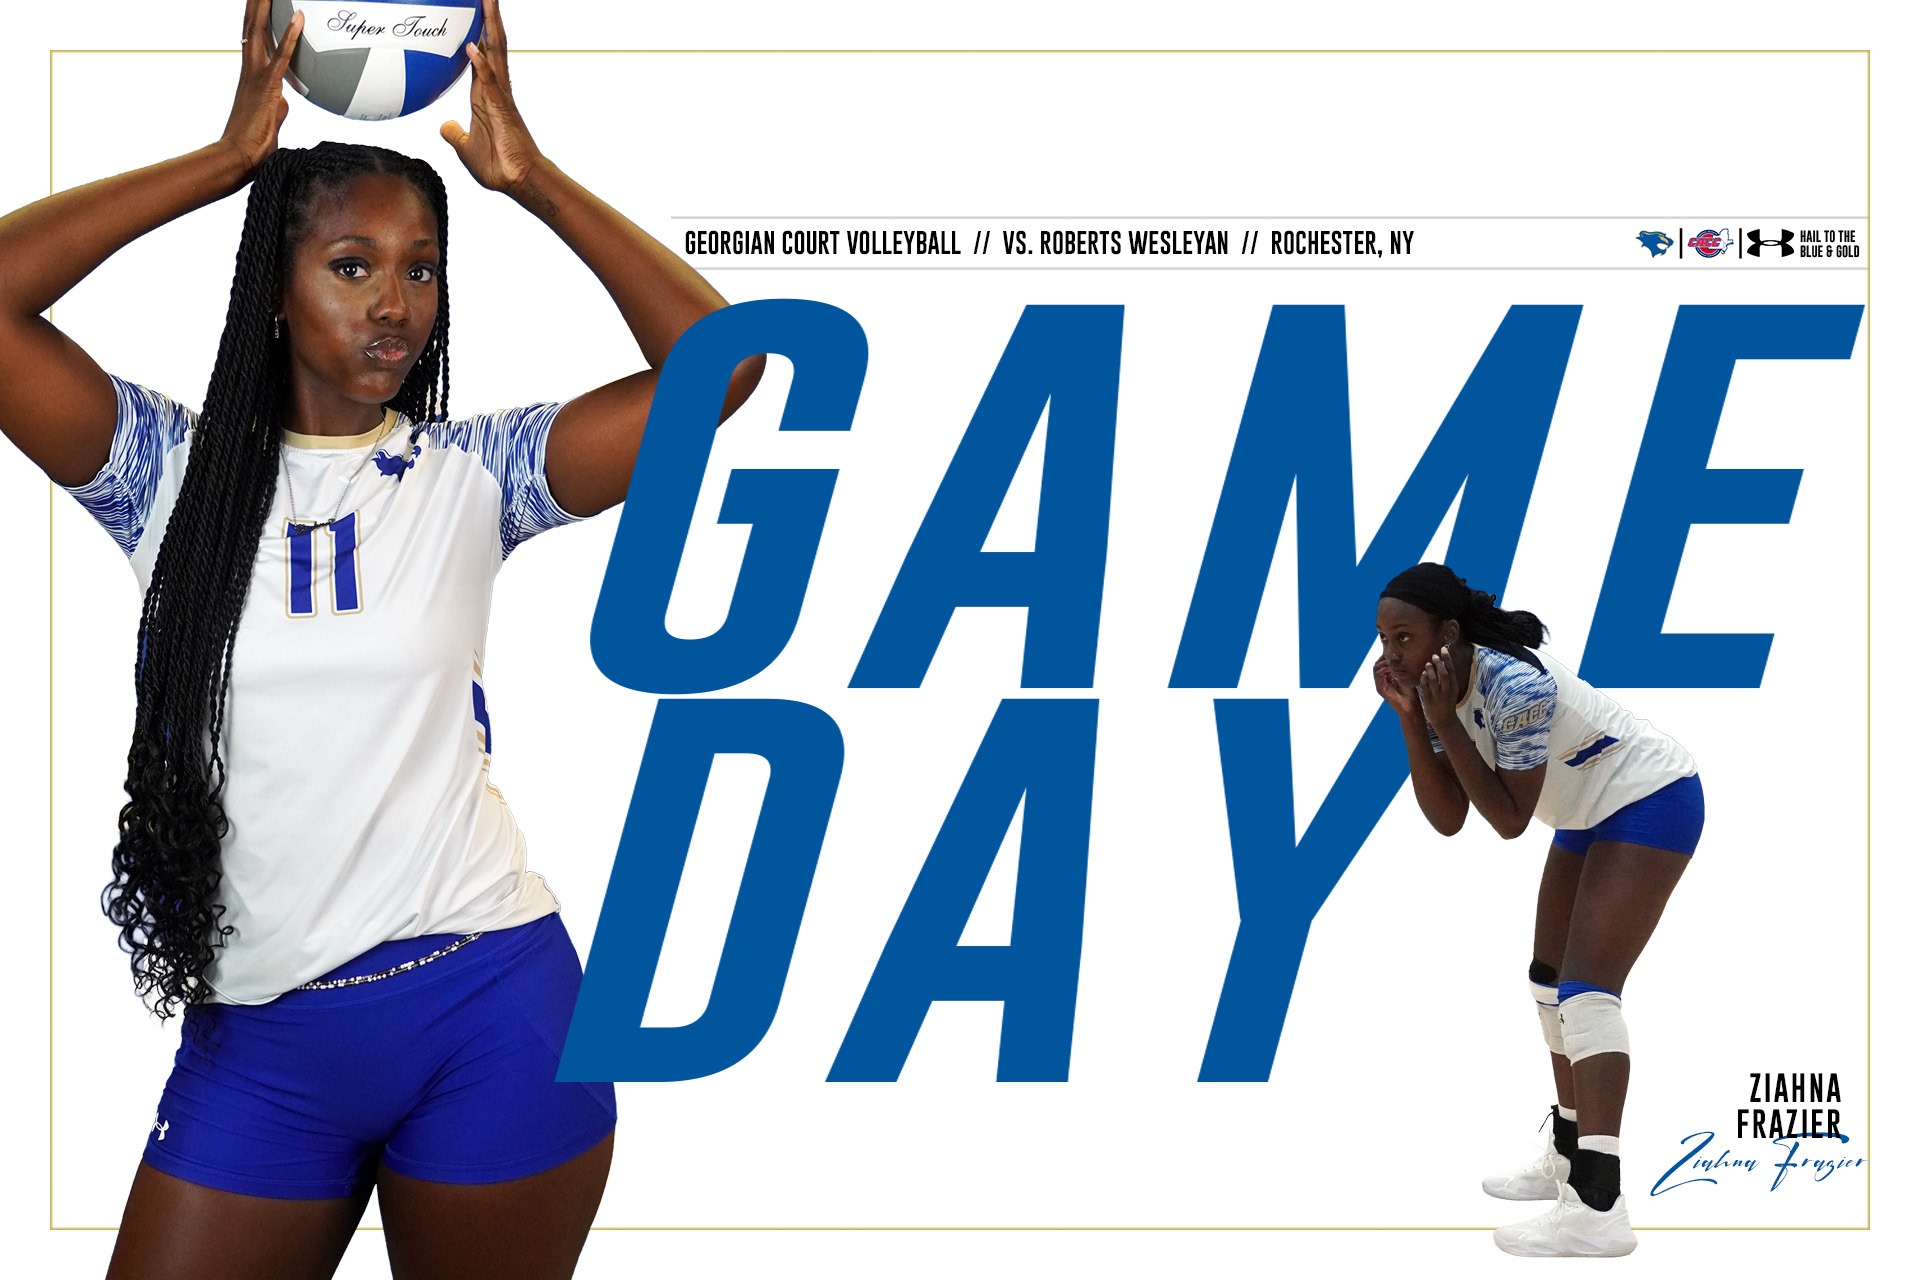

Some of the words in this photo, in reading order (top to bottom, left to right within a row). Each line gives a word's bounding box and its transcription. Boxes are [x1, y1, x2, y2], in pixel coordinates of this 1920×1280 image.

[327, 10, 386, 40] Super
[392, 15, 448, 38] Touch
[283, 510, 363, 619] 11
